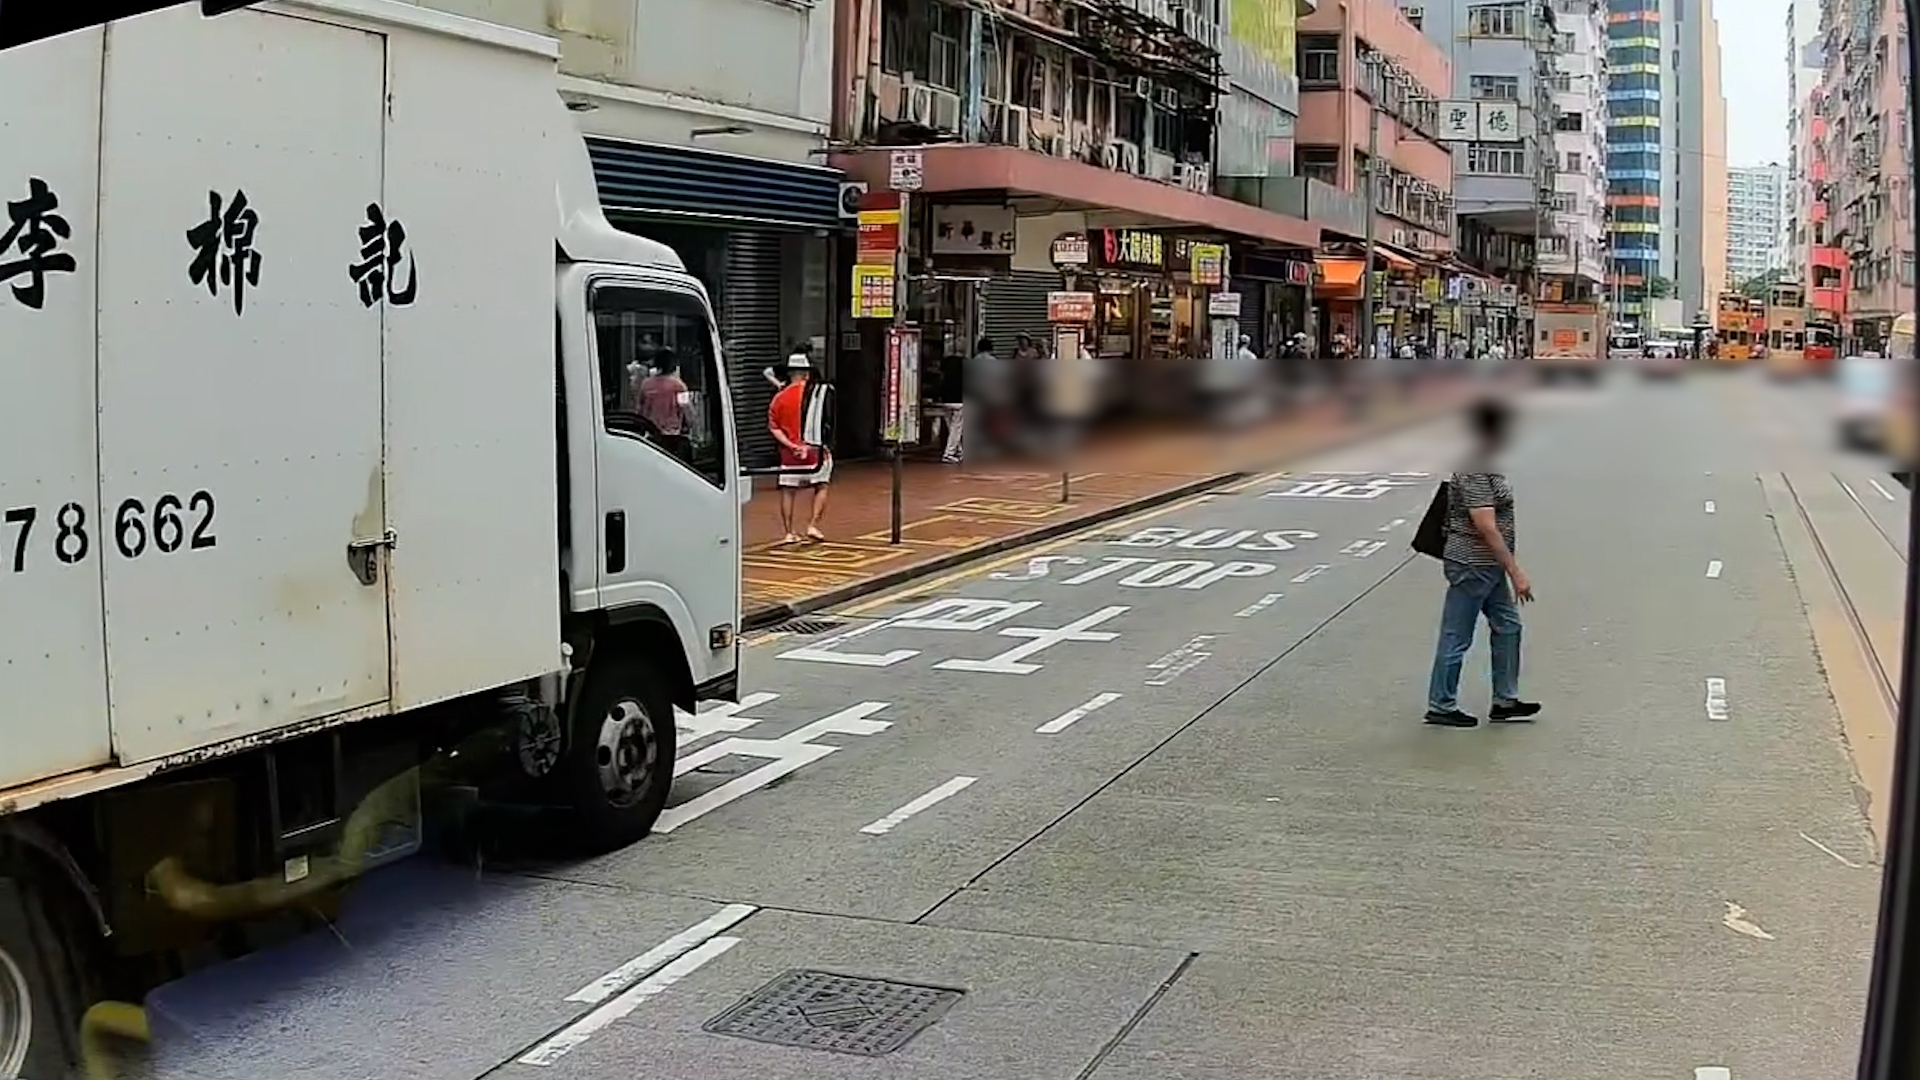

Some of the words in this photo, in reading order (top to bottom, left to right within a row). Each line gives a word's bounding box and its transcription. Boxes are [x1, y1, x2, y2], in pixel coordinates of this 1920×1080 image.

[1450, 108, 1509, 132] 聖德
[0, 177, 418, 317] 李棉記
[1105, 526, 1319, 551] BUS
[988, 554, 1277, 589] STOP
[774, 599, 1132, 675] 巴士
